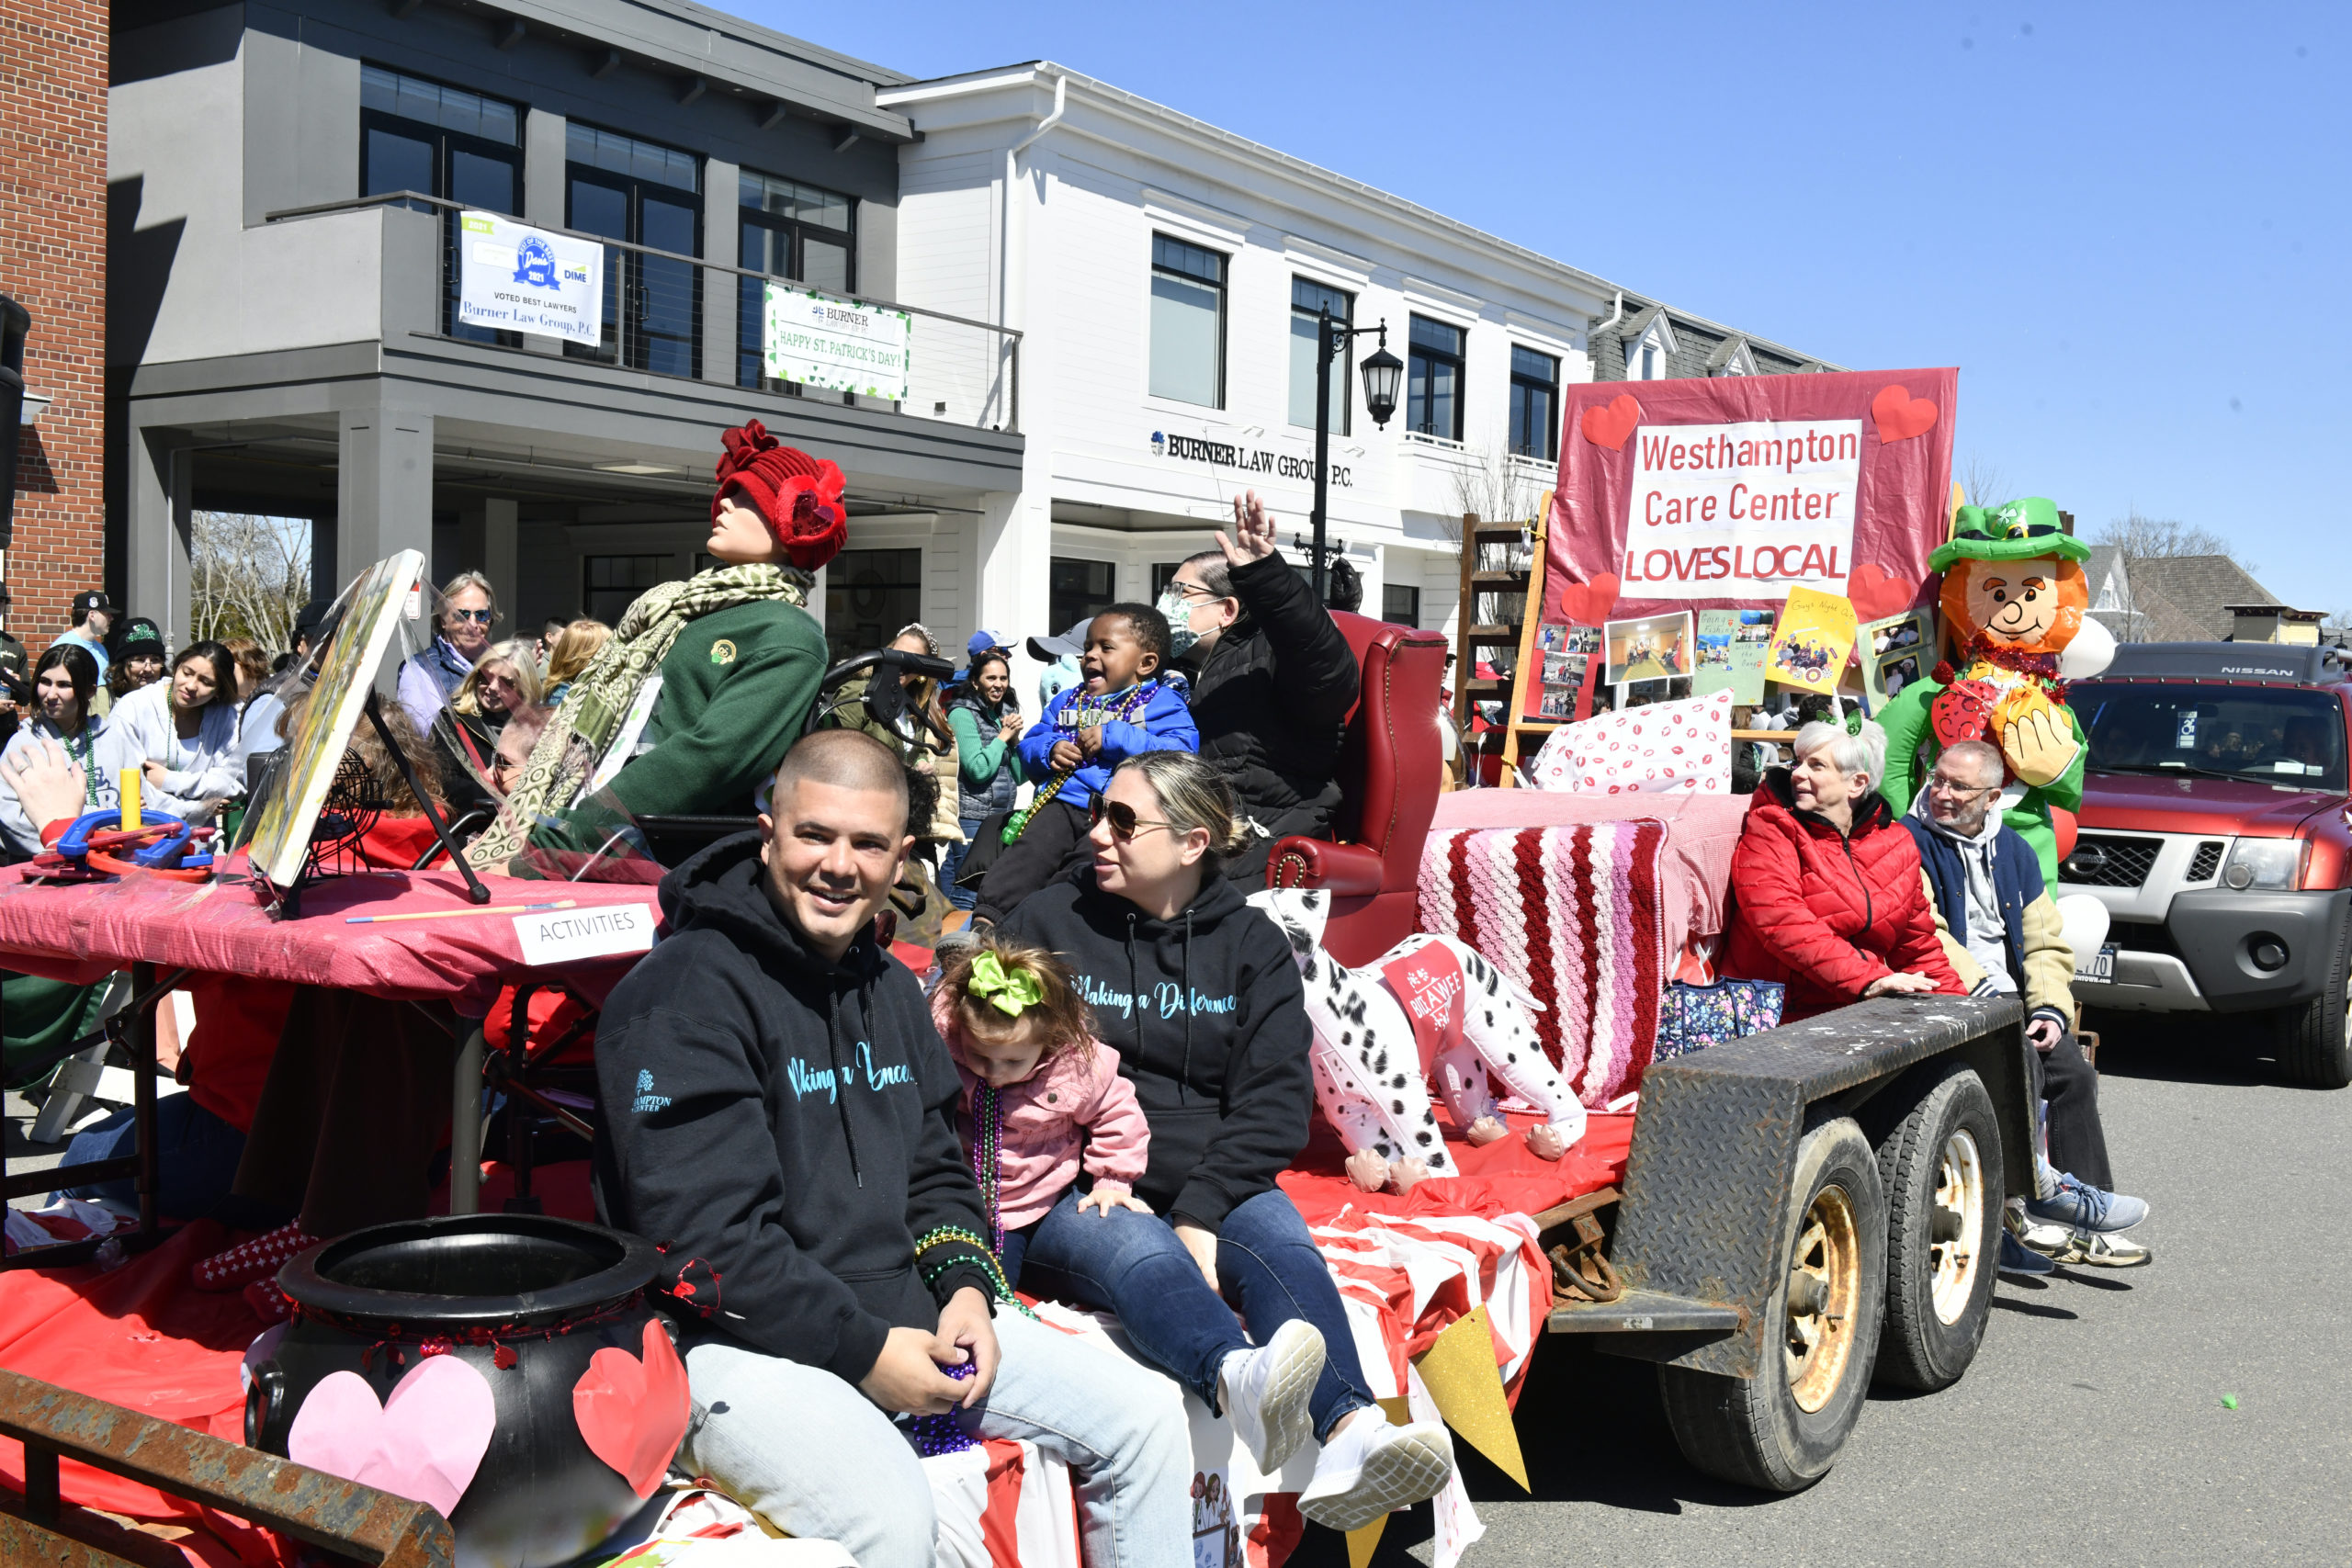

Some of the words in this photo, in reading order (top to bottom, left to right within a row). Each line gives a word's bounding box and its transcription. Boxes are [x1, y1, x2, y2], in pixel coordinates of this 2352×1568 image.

[469, 220, 487, 231] 2021
[528, 270, 545, 283] 2021
[564, 269, 587, 283] DIME
[494, 291, 521, 303] VOTED
[523, 297, 541, 307] BEST
[544, 301, 577, 314] LAWYERS
[827, 307, 868, 327] BURNER
[464, 300, 509, 320] Burner
[514, 309, 537, 324] Law
[539, 313, 575, 334] Group,
[578, 324, 595, 337] P.C.
[780, 331, 811, 350] HAPPY
[813, 338, 827, 354] ST.
[830, 341, 876, 360] PATRICK'S
[877, 351, 901, 367] DAY!
[1168, 434, 1237, 468] BURNER
[1238, 447, 1275, 474] LAW
[1278, 455, 1329, 484] GROU
[1331, 465, 1353, 488] P.C.
[1642, 429, 1857, 473] Westhampton
[1645, 490, 1717, 527] Care
[1729, 482, 1839, 522] Center
[1624, 545, 1731, 581] LOVES
[1734, 544, 1847, 580] LOCAL
[2222, 667, 2294, 677] NISSAN
[540, 912, 635, 942] ACTIVITIES
